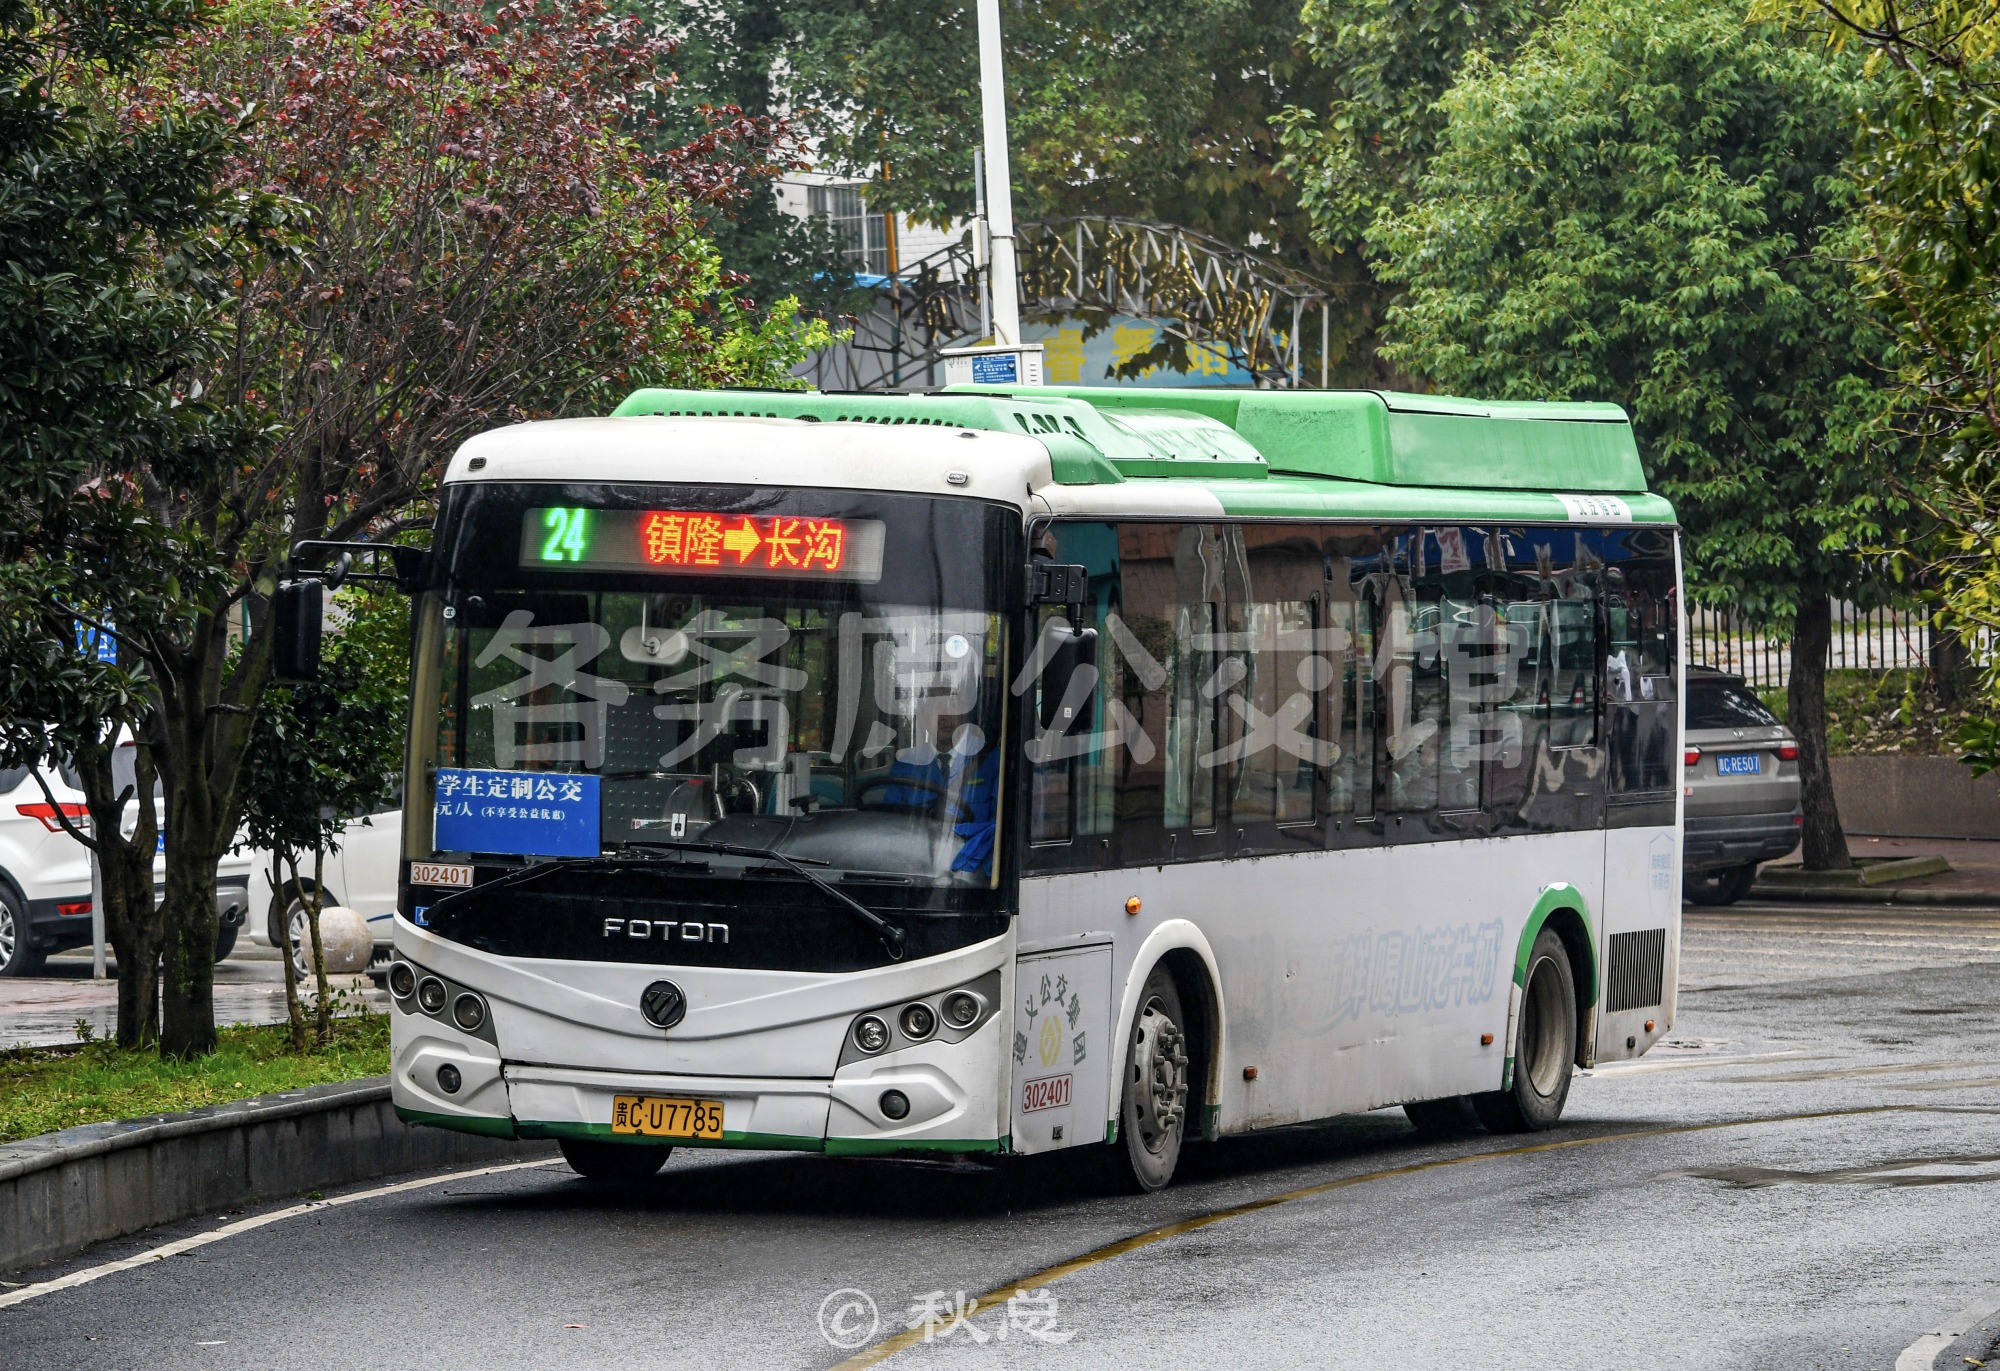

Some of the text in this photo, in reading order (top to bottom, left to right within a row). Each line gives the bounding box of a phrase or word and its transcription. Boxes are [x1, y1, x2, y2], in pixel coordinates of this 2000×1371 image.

[543, 508, 586, 562] 24
[647, 514, 843, 569] 镇隆 长沟
[438, 774, 583, 802] 学生定制公交
[481, 806, 566, 820] (不享受公益优惠)
[413, 865, 469, 885] 302401
[602, 917, 730, 944] FOTON
[1024, 1078, 1070, 1110] 302401
